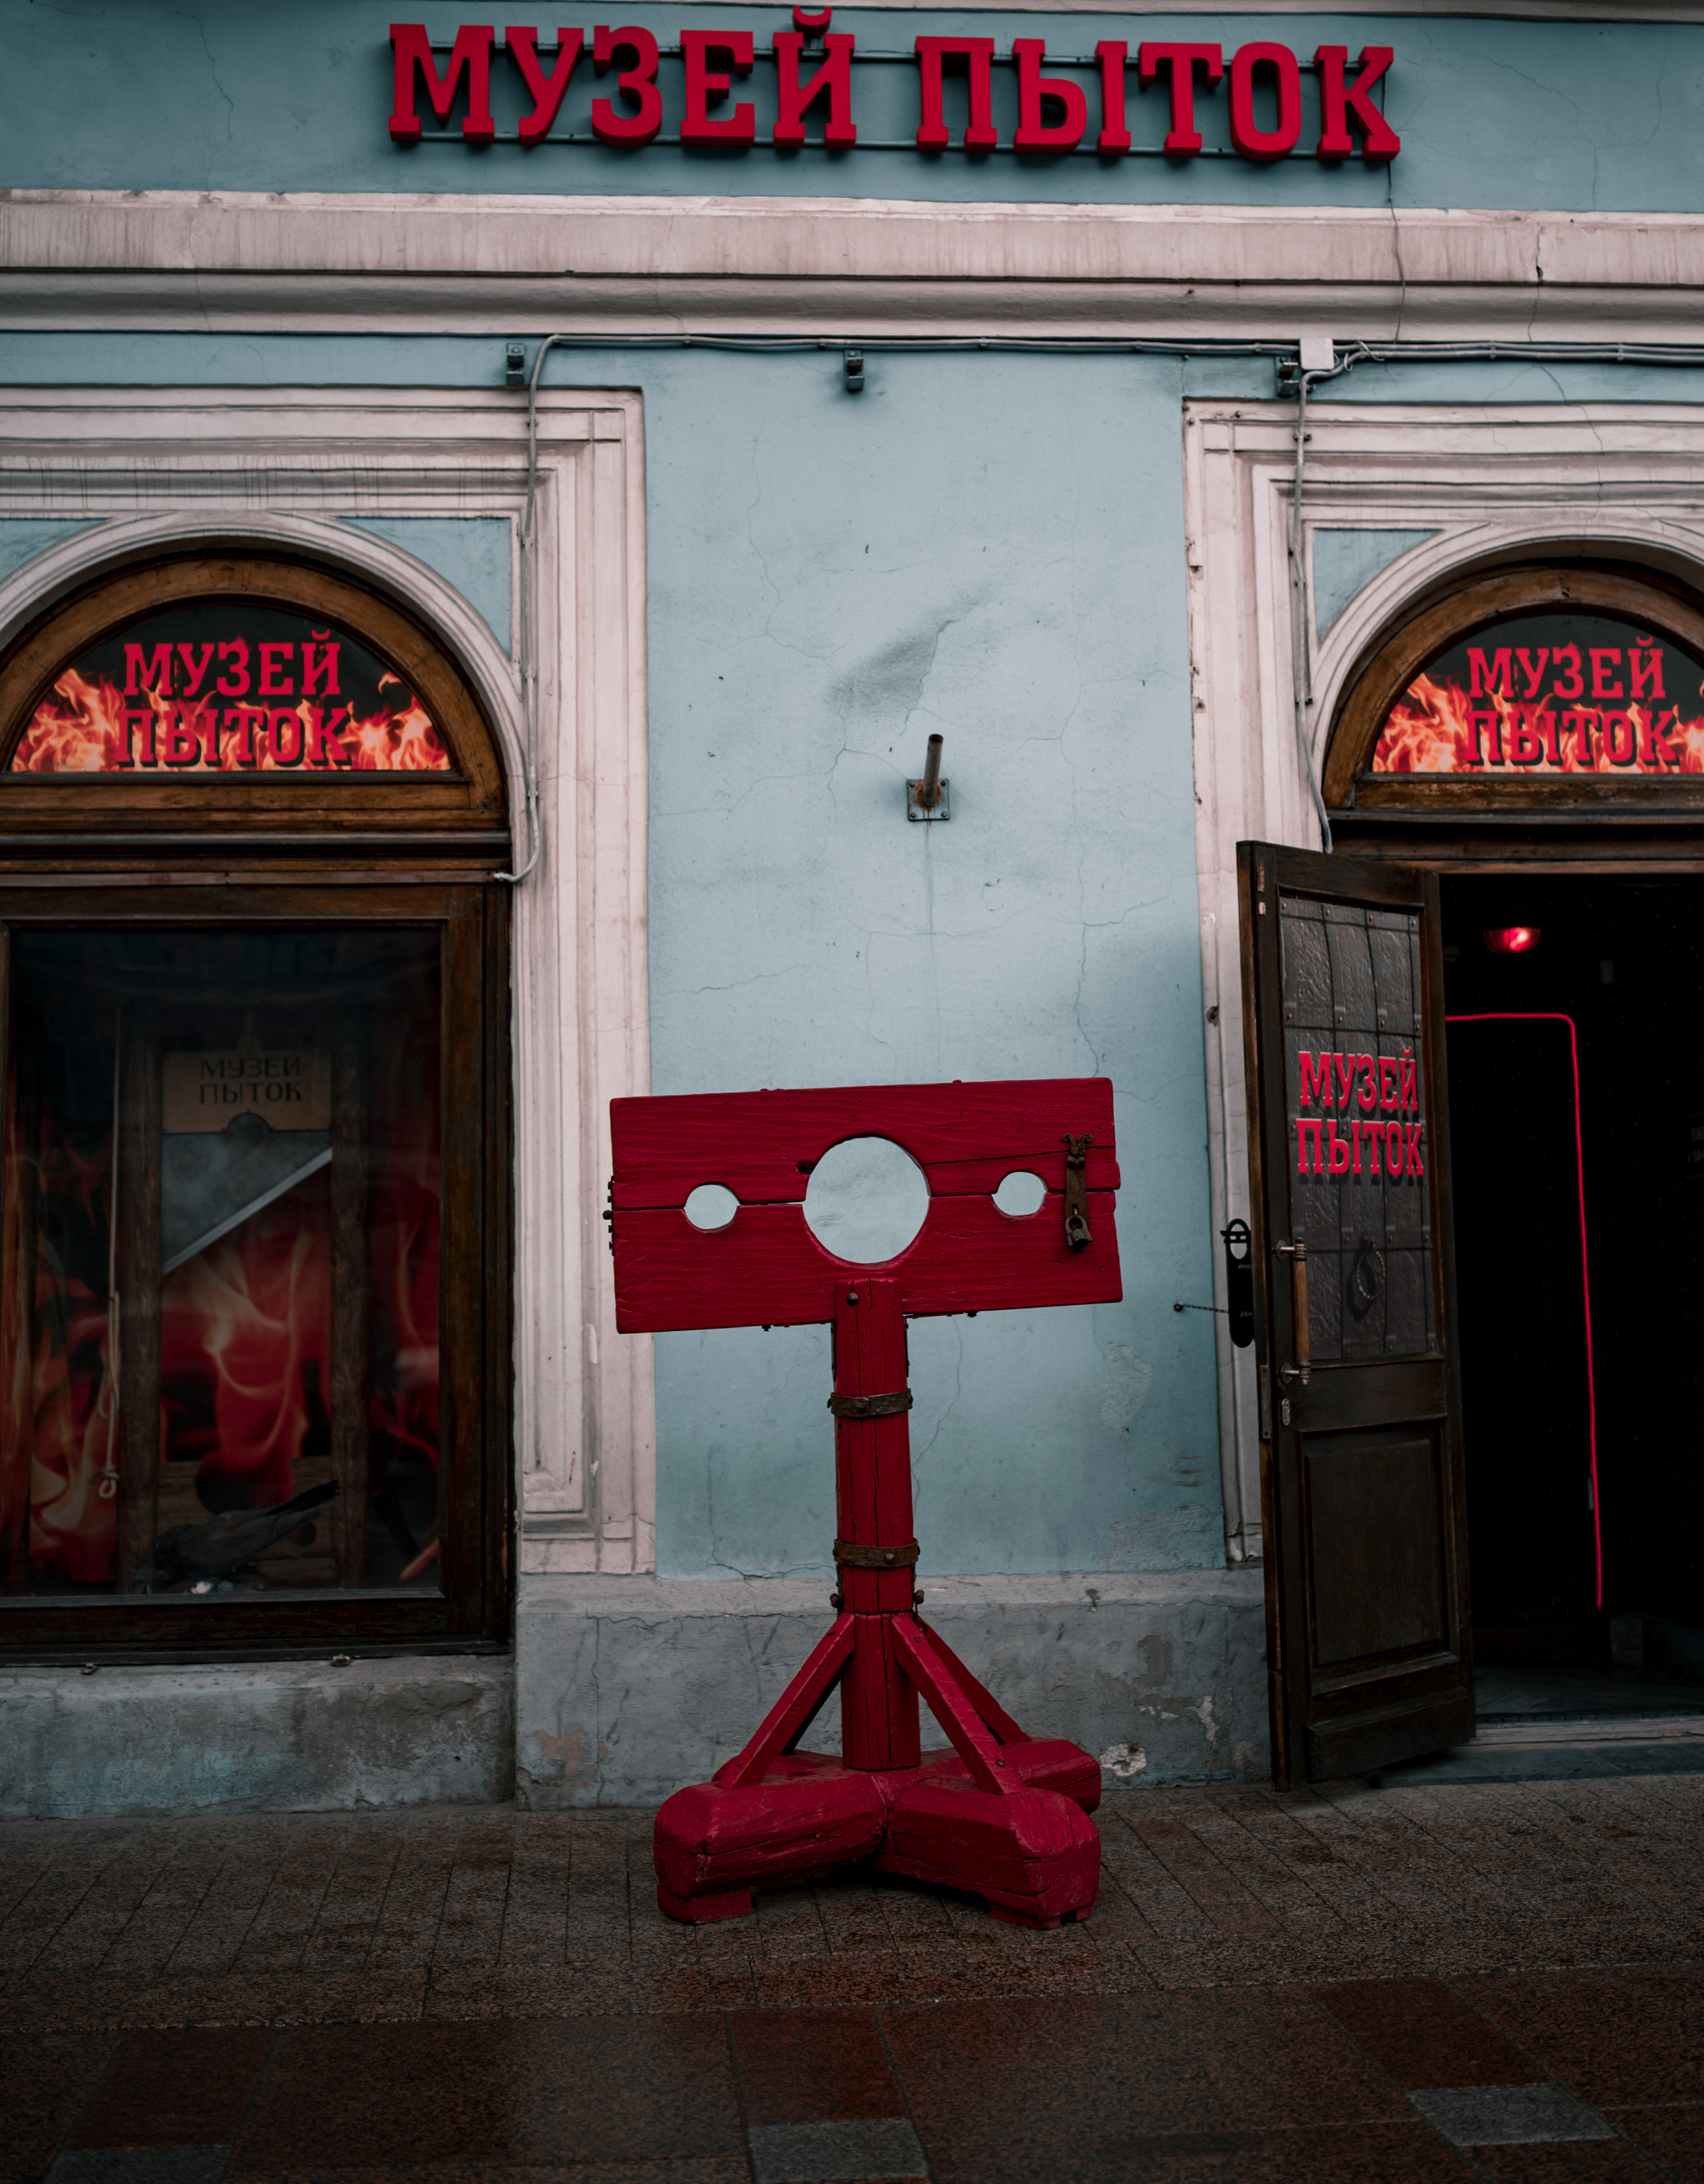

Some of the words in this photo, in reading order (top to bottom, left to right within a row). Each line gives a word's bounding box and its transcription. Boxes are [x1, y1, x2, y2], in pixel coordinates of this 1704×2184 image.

[389, 6, 857, 149] МУЗЕЙ
[914, 36, 1400, 160] ПЫТОК
[123, 630, 341, 696] МУЗЕЙ
[1467, 636, 1666, 699] МУЗЕЙ
[115, 708, 349, 763] ПЫТОК
[1466, 710, 1677, 763] ПЫТОК
[200, 1080, 302, 1104] ПЫТОК
[1298, 1046, 1418, 1111] МУЗЕЙ
[1296, 1118, 1424, 1176] ПЫТОК
